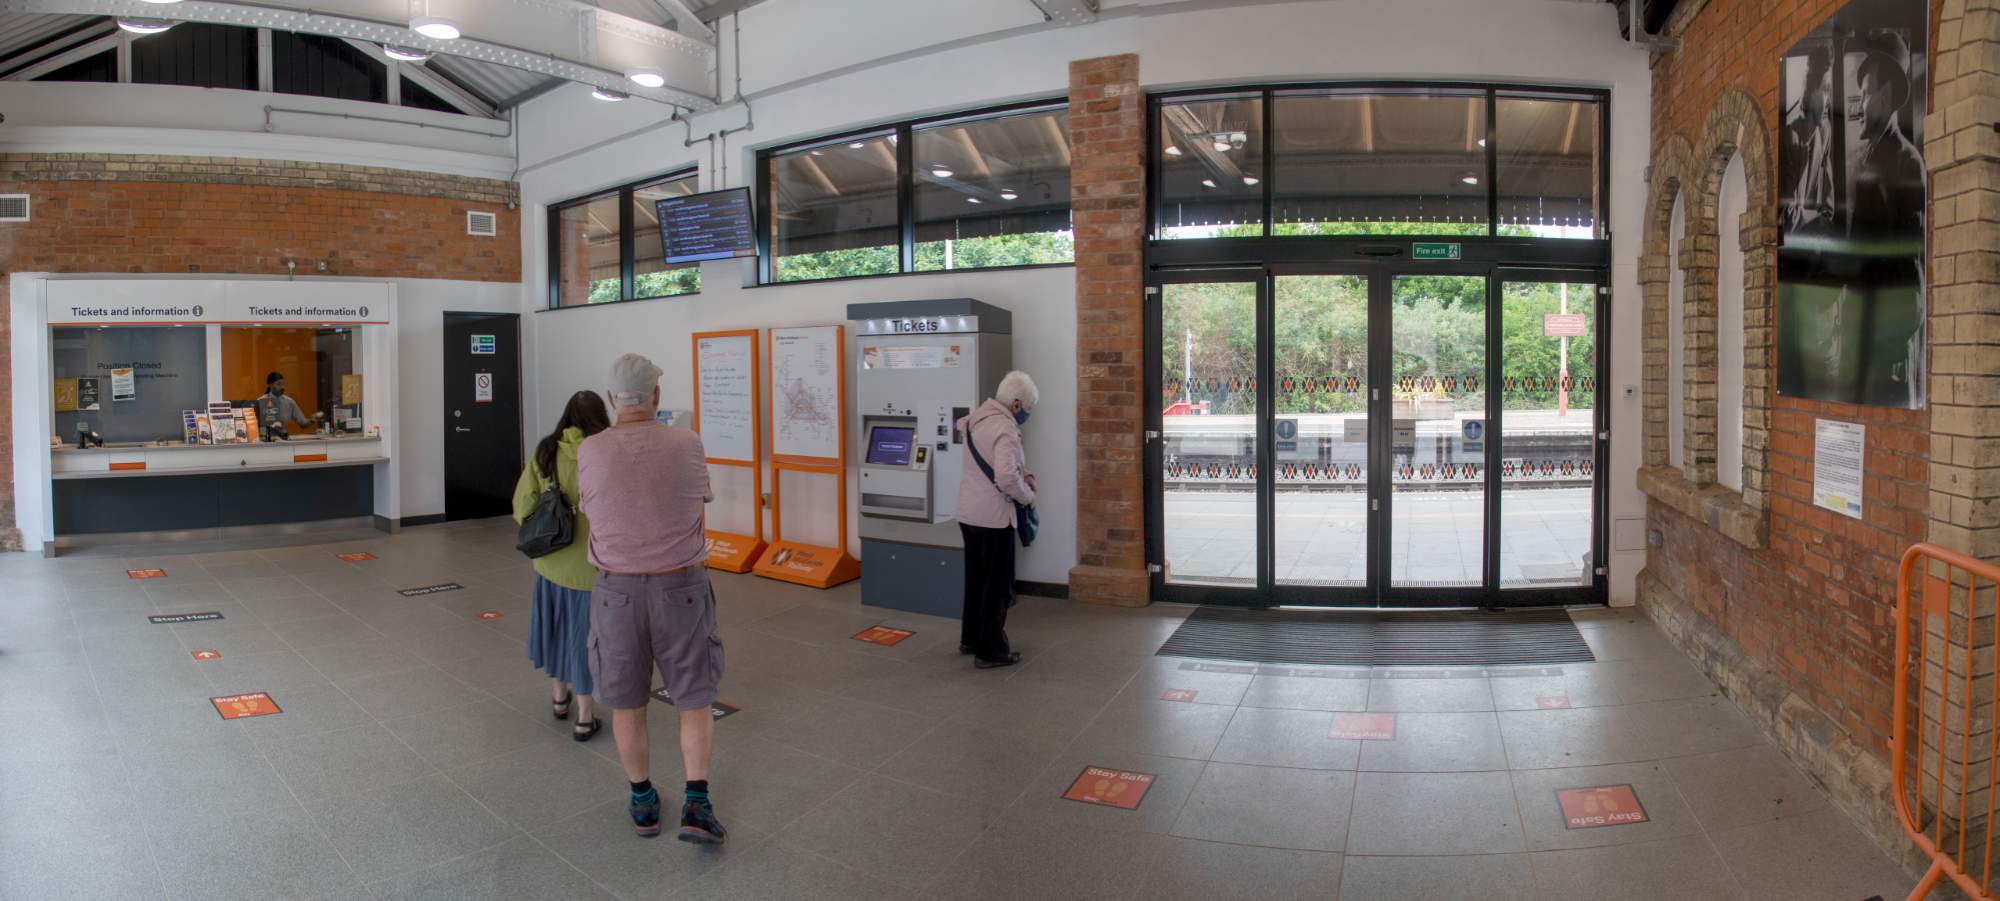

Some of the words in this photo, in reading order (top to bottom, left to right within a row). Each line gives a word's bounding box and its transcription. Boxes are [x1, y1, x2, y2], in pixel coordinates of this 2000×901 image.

[71, 306, 108, 317] Tickets
[110, 306, 129, 317] and
[131, 305, 190, 317] information
[248, 306, 283, 316] Tickets
[285, 306, 302, 316] and
[304, 306, 357, 317] information
[891, 319, 938, 332] Tickets
[132, 361, 161, 369] Closed
[1087, 768, 1118, 779] Stay
[1119, 772, 1150, 782] Safe
[1570, 815, 1605, 825] Safe
[1608, 811, 1643, 820] Stay
